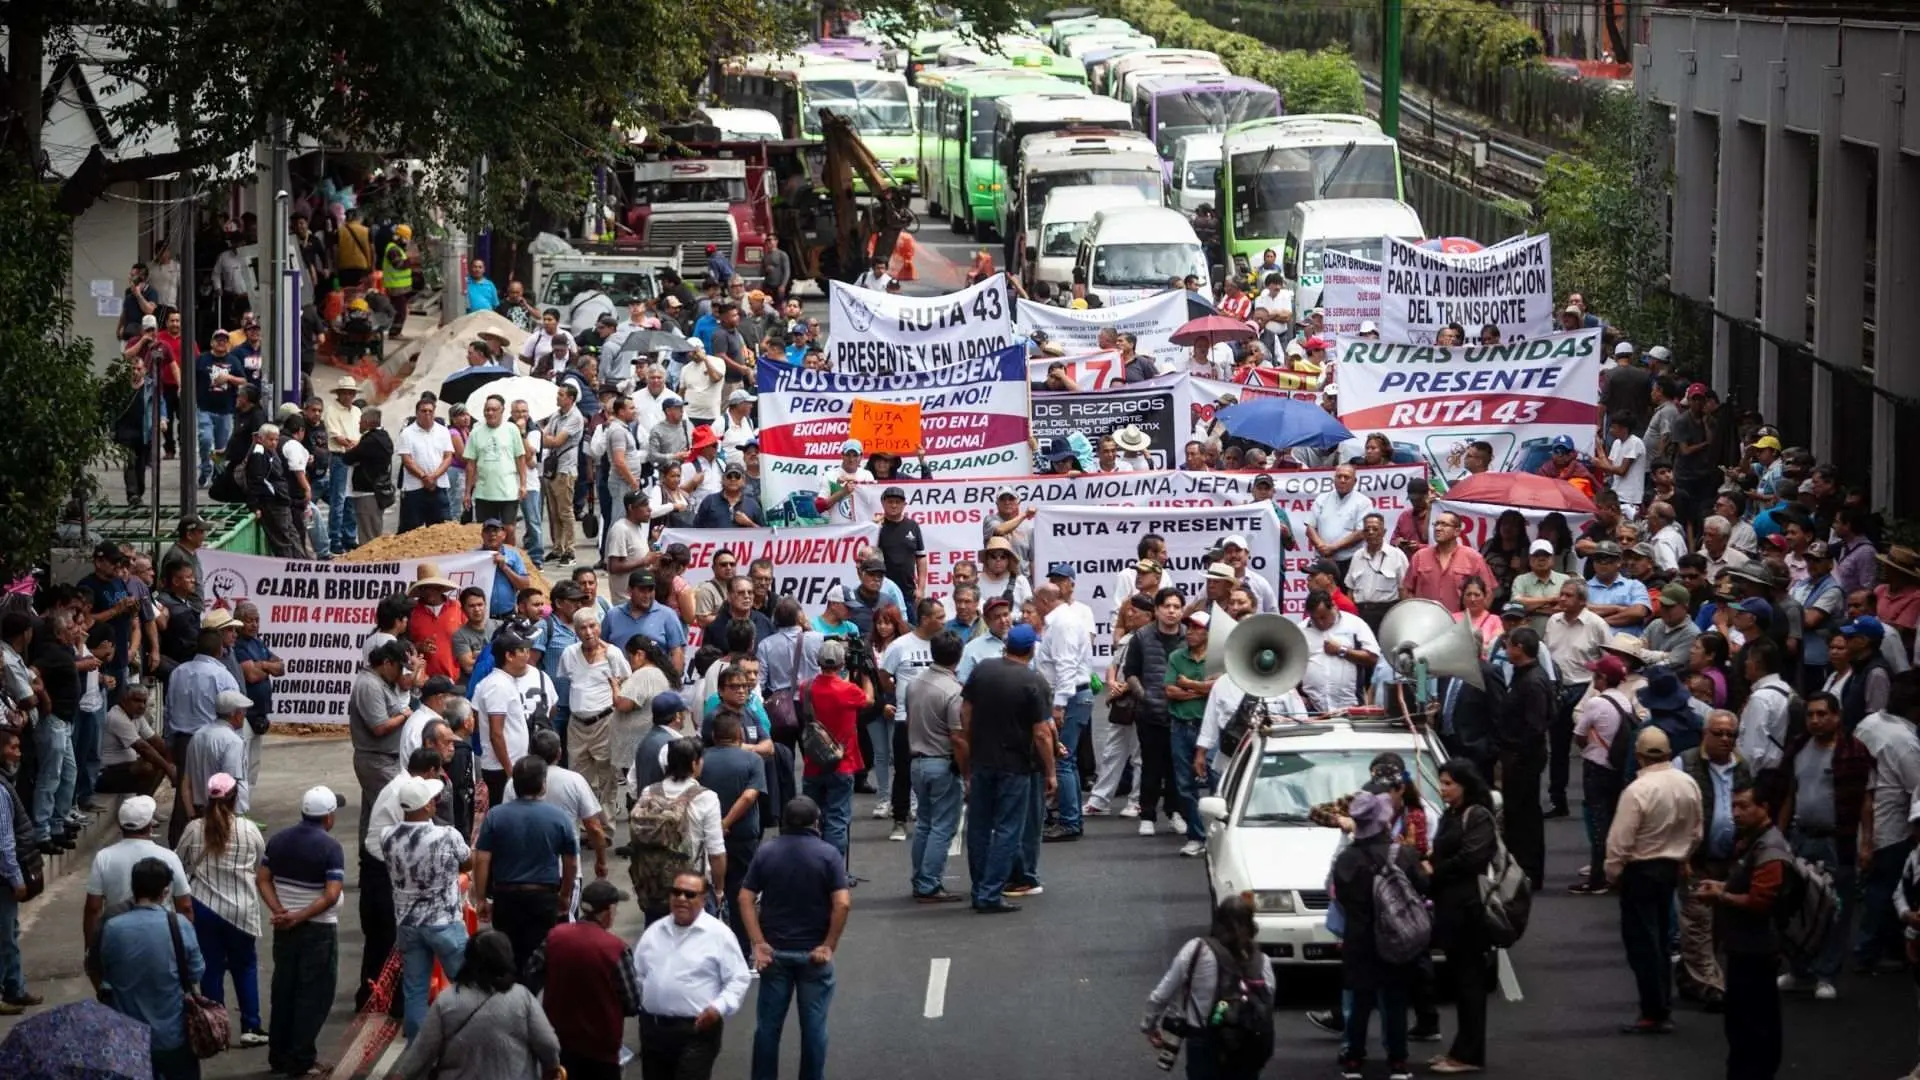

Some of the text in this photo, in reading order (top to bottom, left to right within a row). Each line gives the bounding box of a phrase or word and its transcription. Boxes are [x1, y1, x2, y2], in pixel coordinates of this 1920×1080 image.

[1323, 253, 1347, 270] CLARA
[1390, 241, 1418, 266] POR
[1420, 252, 1448, 272] UNA
[1452, 254, 1499, 274] TARIFA
[1501, 241, 1544, 270] JUSTA
[1387, 269, 1546, 298] PARA LA DIGNIFICACION
[897, 287, 1003, 332] RUTA 43
[1407, 298, 1527, 326] DEL TRANSPORTE
[837, 342, 916, 373] PRESENTE
[916, 345, 928, 371] Y
[932, 341, 951, 367] EN
[1342, 342, 1453, 364] RUTAS
[1462, 334, 1598, 364] UNIDAS
[1378, 366, 1563, 393] PRESENTE
[789, 396, 844, 414] PERO
[950, 385, 992, 407] NO!!
[1034, 398, 1165, 417] DE REZAGOS
[948, 415, 970, 429] EN
[970, 414, 989, 428] LA
[1050, 418, 1071, 427] DEL
[1073, 414, 1143, 426] TRANSPORTE
[1388, 400, 1546, 428] RUTA 43
[925, 437, 936, 450] Y
[938, 431, 987, 449] DIGNA!
[1094, 426, 1111, 434] DE
[771, 460, 819, 476] PARA
[899, 449, 1019, 475] RABAJANDO.
[963, 483, 1078, 505] BRGADA
[1084, 474, 1178, 500] MOLINA,
[1184, 473, 1240, 495] JEFA
[1284, 472, 1408, 495] GOBRNO
[1052, 516, 1262, 537] RUTA 47 PRESENTE
[761, 534, 871, 566] AUMENTO
[1047, 558, 1140, 574] EXIGIMO
[255, 577, 320, 600] CLARA
[324, 578, 417, 601] BRUGAD
[1092, 584, 1107, 599] A
[271, 605, 378, 625] RUTA 4 PRESEN
[308, 633, 353, 650] DIGNO,
[355, 633, 371, 649] U
[287, 658, 353, 674] GOBIERNO
[271, 679, 352, 695] HOMOLOGAR
[277, 699, 326, 714] ESTADO
[328, 700, 345, 715] DE
